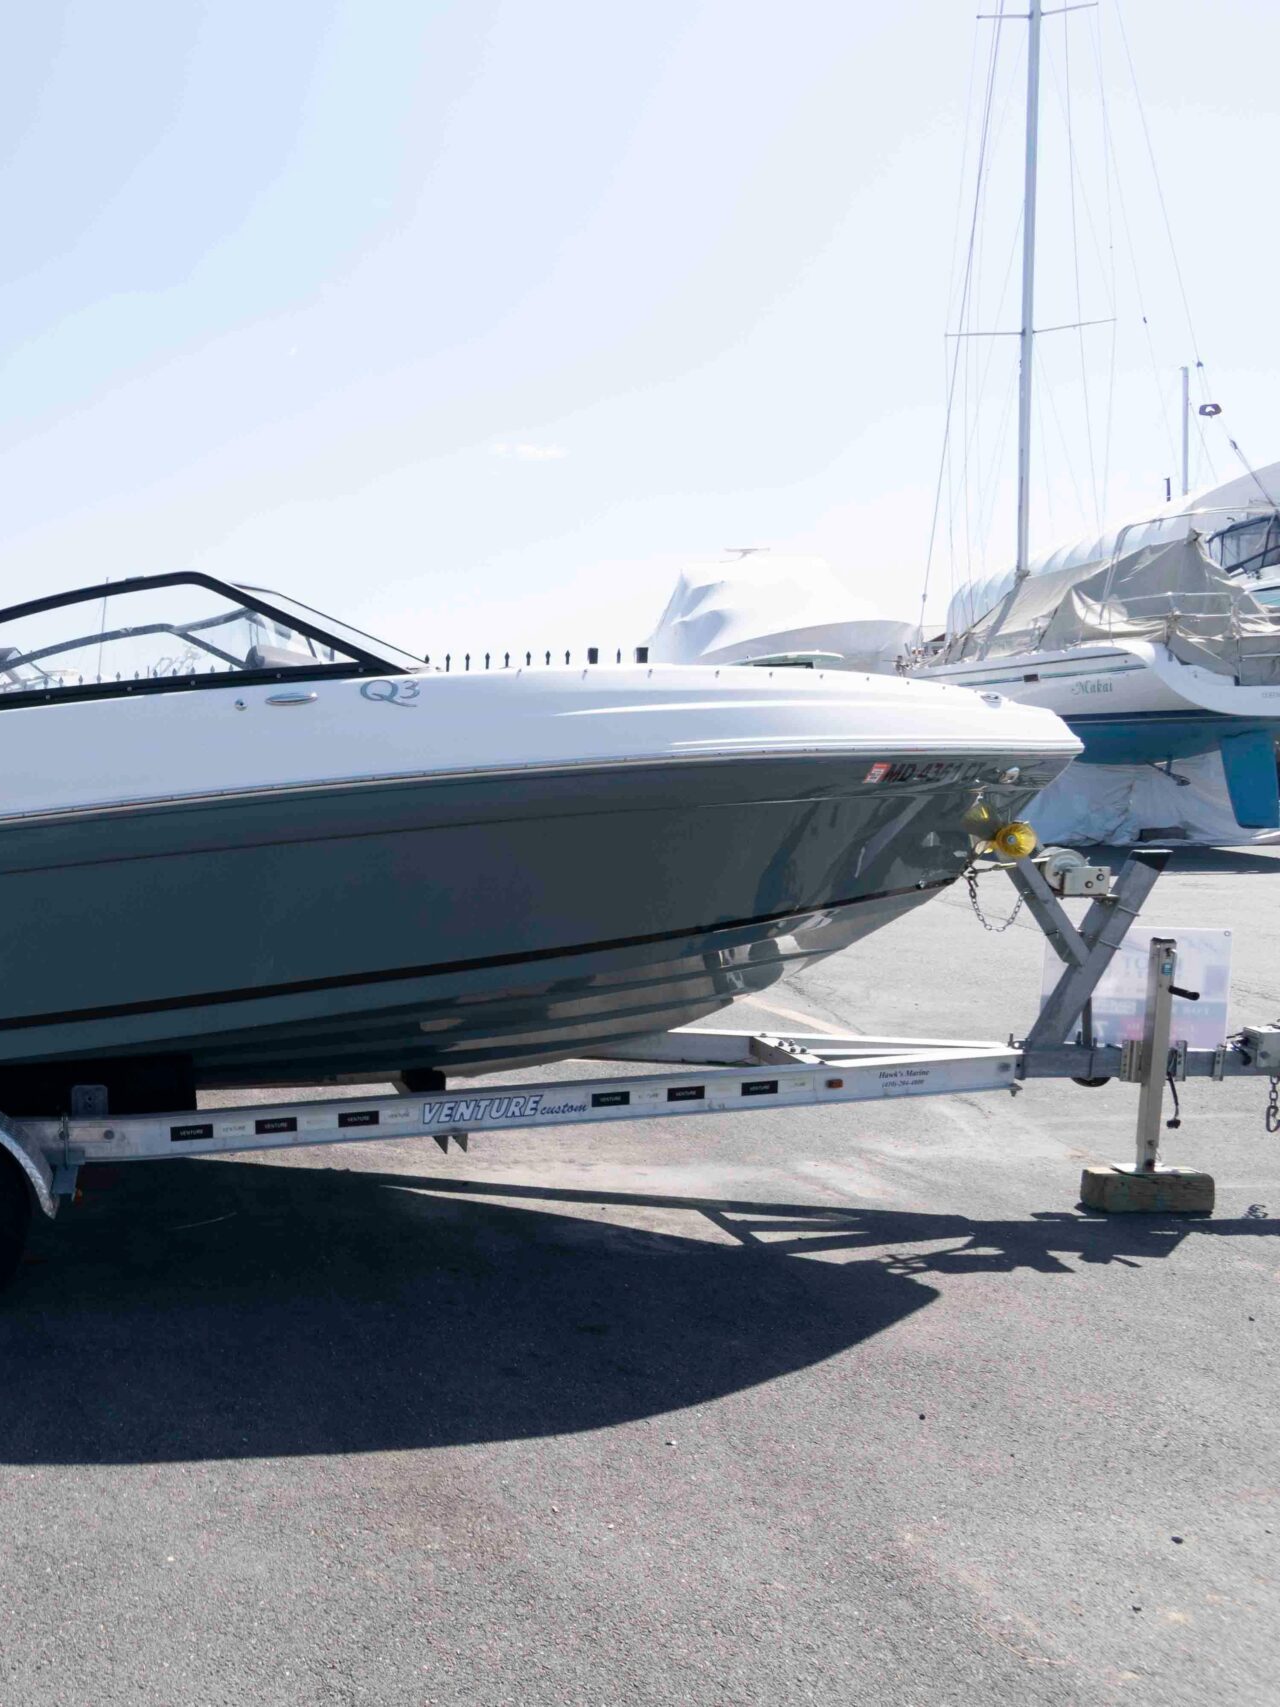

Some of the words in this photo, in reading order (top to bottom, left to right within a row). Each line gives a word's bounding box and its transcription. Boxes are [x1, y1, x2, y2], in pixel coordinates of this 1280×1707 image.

[360, 679, 421, 708] Q3
[423, 1094, 543, 1124] VENTURE
[540, 1103, 588, 1116] custom
